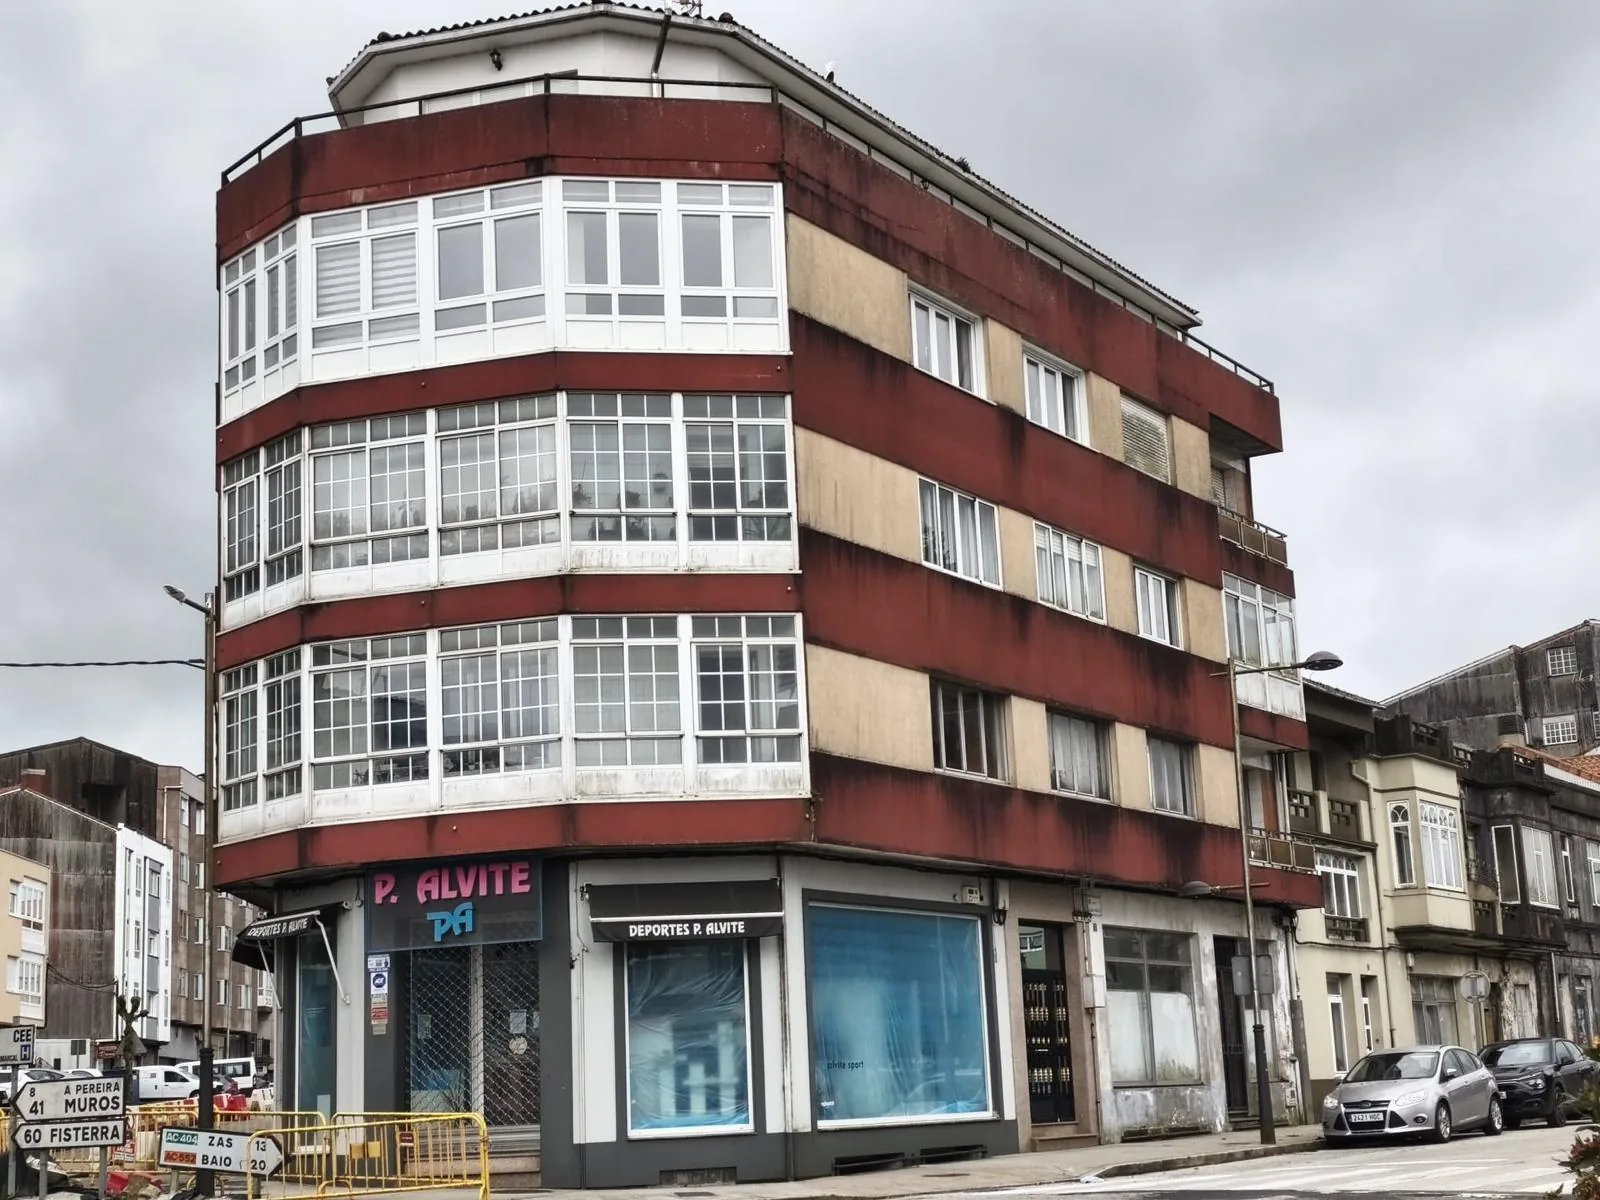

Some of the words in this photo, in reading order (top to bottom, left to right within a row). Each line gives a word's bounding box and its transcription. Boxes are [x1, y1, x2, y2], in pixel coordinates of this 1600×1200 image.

[374, 872, 400, 905] P.
[416, 861, 531, 905] ALVITE
[247, 922, 281, 937] DEPORTES
[288, 917, 308, 934] ALVITE
[629, 923, 690, 937] DEPORTES
[693, 922, 702, 935] P.
[706, 921, 745, 935] ALVITE
[13, 1029, 31, 1043] CEE
[848, 1060, 864, 1071] sport
[29, 1087, 36, 1098] 8
[64, 1085, 71, 1096] A
[76, 1081, 120, 1095] PEREIRA
[29, 1100, 44, 1115] 41
[64, 1096, 120, 1113] MUROS
[24, 1128, 42, 1144] 60
[50, 1125, 120, 1143] FISTERRA
[166, 1132, 198, 1146] AC-404
[208, 1135, 233, 1148] ZAS
[255, 1140, 266, 1152] 13
[201, 1154, 232, 1167] BAIO
[250, 1160, 266, 1171] 20
